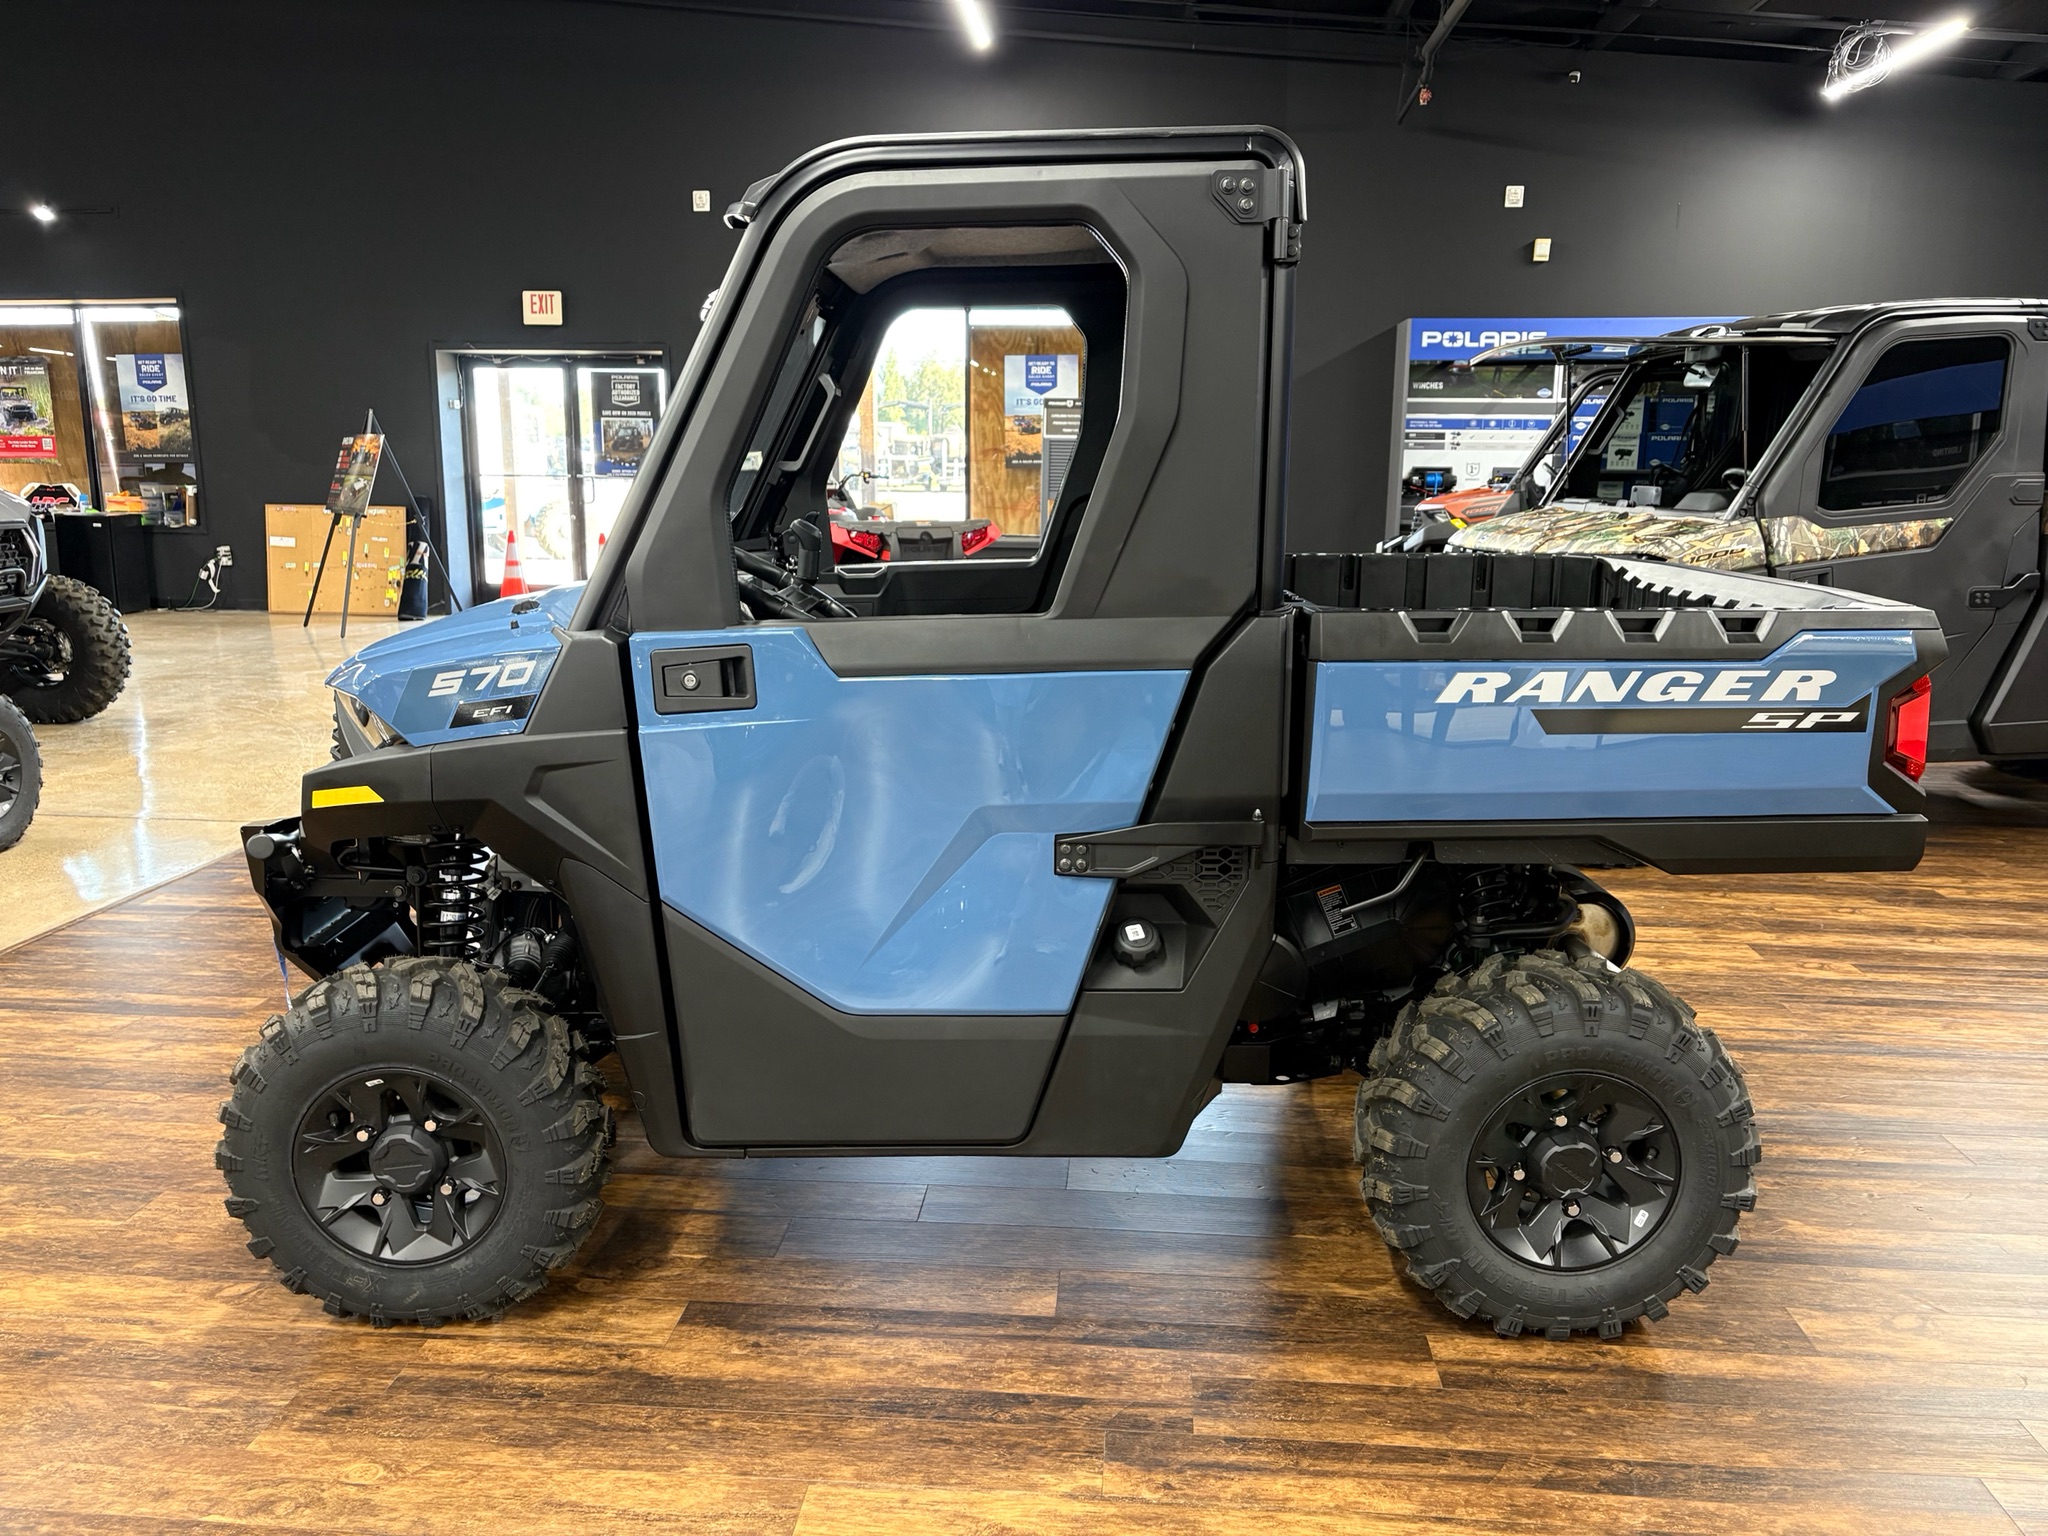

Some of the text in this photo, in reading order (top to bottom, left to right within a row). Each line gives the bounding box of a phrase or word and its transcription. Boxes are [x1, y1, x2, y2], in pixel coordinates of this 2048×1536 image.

[530, 294, 554, 314] EXIT
[141, 365, 160, 373] RIDE
[1031, 366, 1052, 374] RIDE
[1412, 381, 1444, 390] WINCHES
[130, 395, 177, 403] IT'S GO TIME
[1016, 398, 1032, 406] IT'S
[1466, 505, 1499, 514] 1000
[1676, 528, 1756, 558] XP
[1690, 548, 1746, 564] 1000
[428, 661, 537, 697] 570
[1435, 670, 1837, 704] RANGER
[472, 705, 513, 718] EFI
[1741, 712, 1860, 729] SP
[1598, 1048, 1678, 1091] ARMOR
[1462, 1245, 1609, 1307] X-TERRAIN
